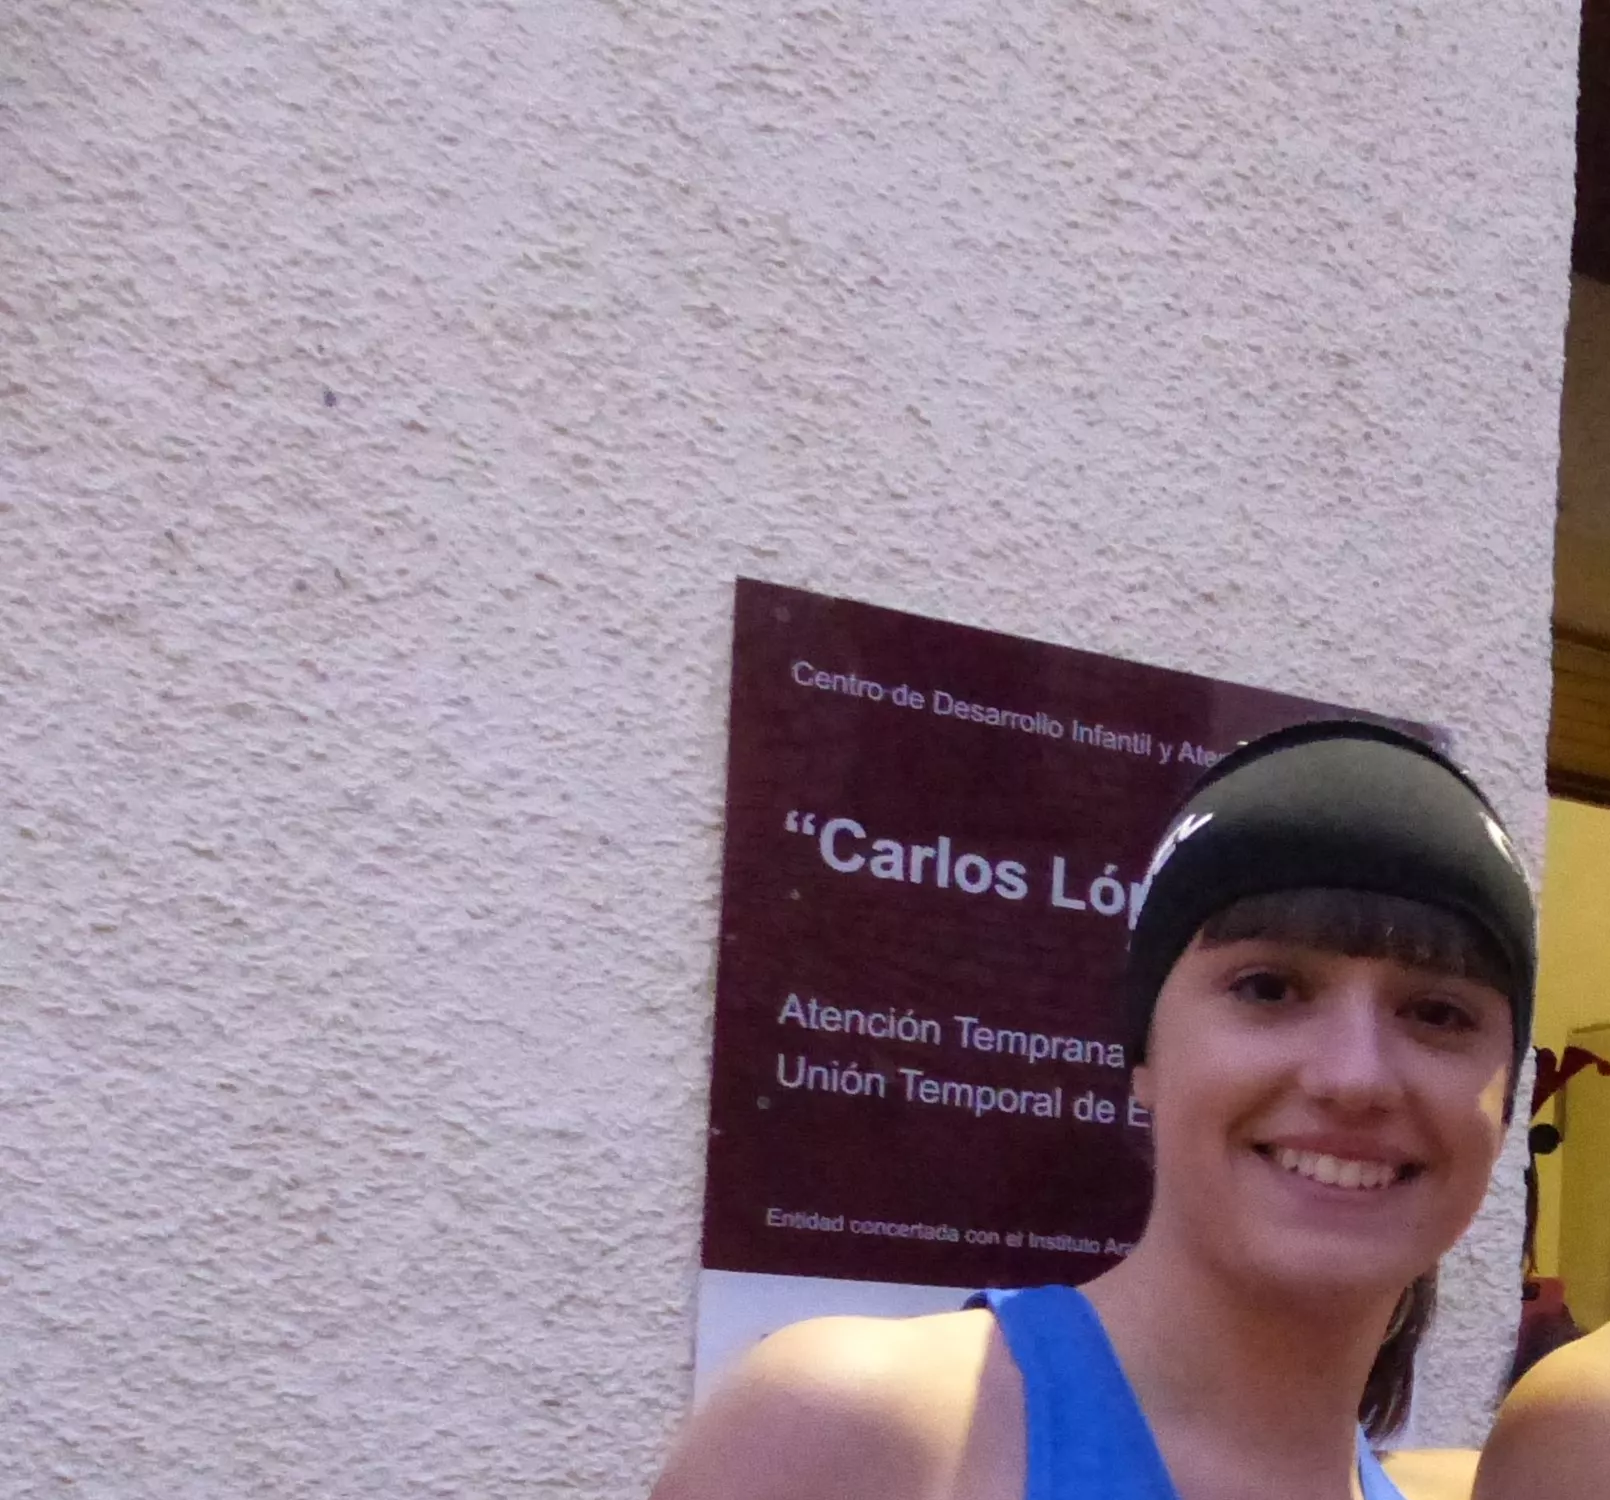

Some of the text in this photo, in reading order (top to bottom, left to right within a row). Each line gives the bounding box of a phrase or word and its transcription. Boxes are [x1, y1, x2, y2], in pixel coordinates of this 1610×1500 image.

[791, 660, 883, 701] Centro
[892, 684, 925, 710] de
[932, 689, 1063, 739] Desarrollo
[1072, 718, 1152, 757] Infantil
[1159, 740, 1172, 765] y
[778, 993, 1125, 1069] Atención Temprana
[777, 1053, 886, 1098] Unión
[899, 1068, 1062, 1116] Temporal
[1073, 1090, 1116, 1123] de
[766, 1208, 845, 1232] Entidad
[964, 1229, 1000, 1245] con
